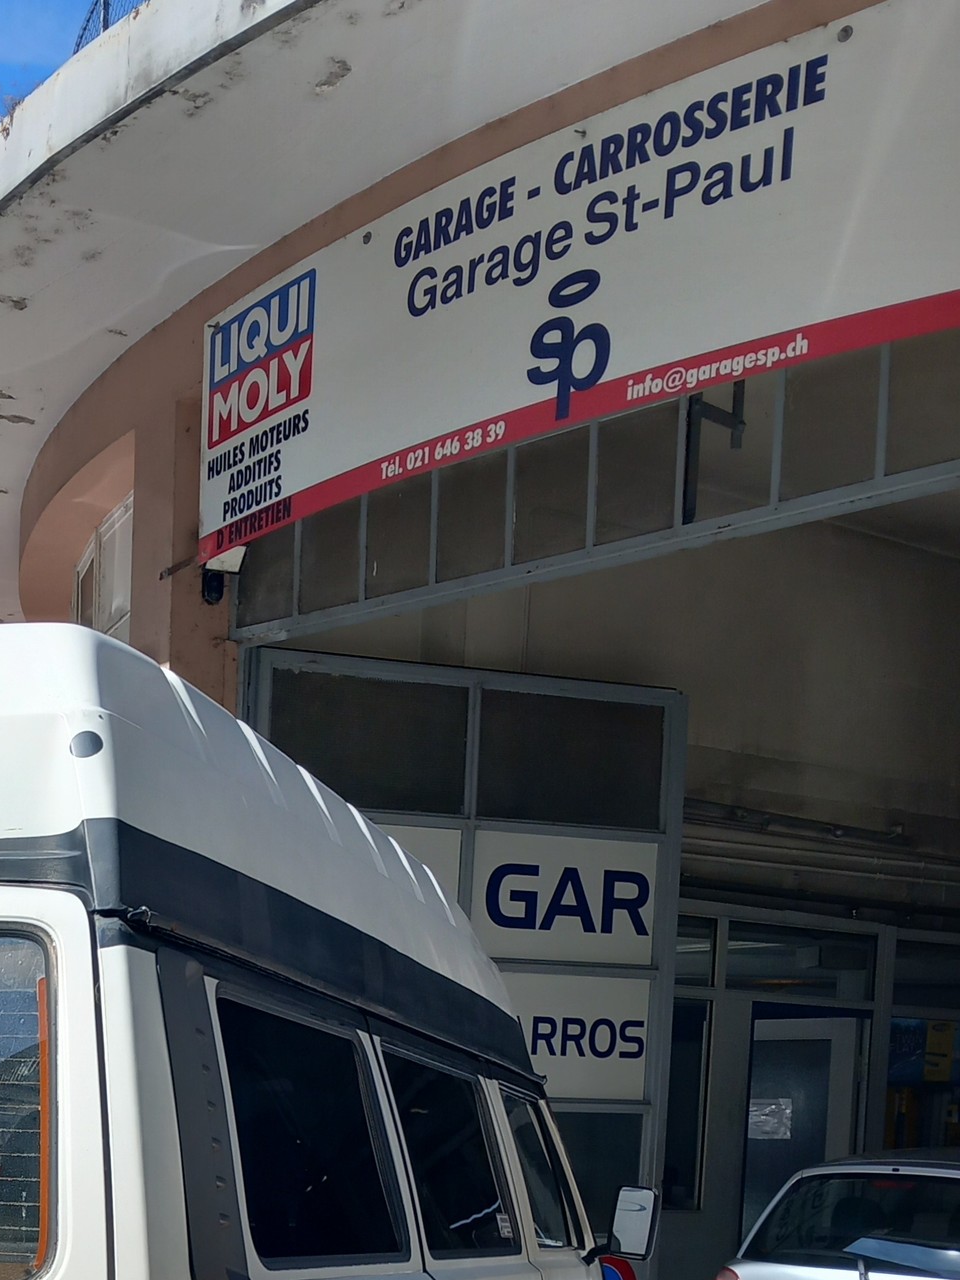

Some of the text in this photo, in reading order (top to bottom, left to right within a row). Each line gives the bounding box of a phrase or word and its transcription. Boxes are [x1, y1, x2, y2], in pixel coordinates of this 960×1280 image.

[393, 176, 516, 268] GARAGE
[553, 54, 829, 195] CARROSSERIE
[407, 126, 795, 318] Garage St-Paul
[214, 277, 310, 383] LIQUI
[212, 339, 312, 443] MOLY
[626, 333, 809, 401] info@garagesp.ch
[207, 409, 309, 480] HUILES MOTEURS
[228, 449, 281, 495] ADDITIFS
[381, 421, 505, 480] Tél. 021 646 38 39
[223, 475, 282, 522] PRODUITS
[486, 863, 650, 936] GAR
[517, 1015, 645, 1059] RROS
